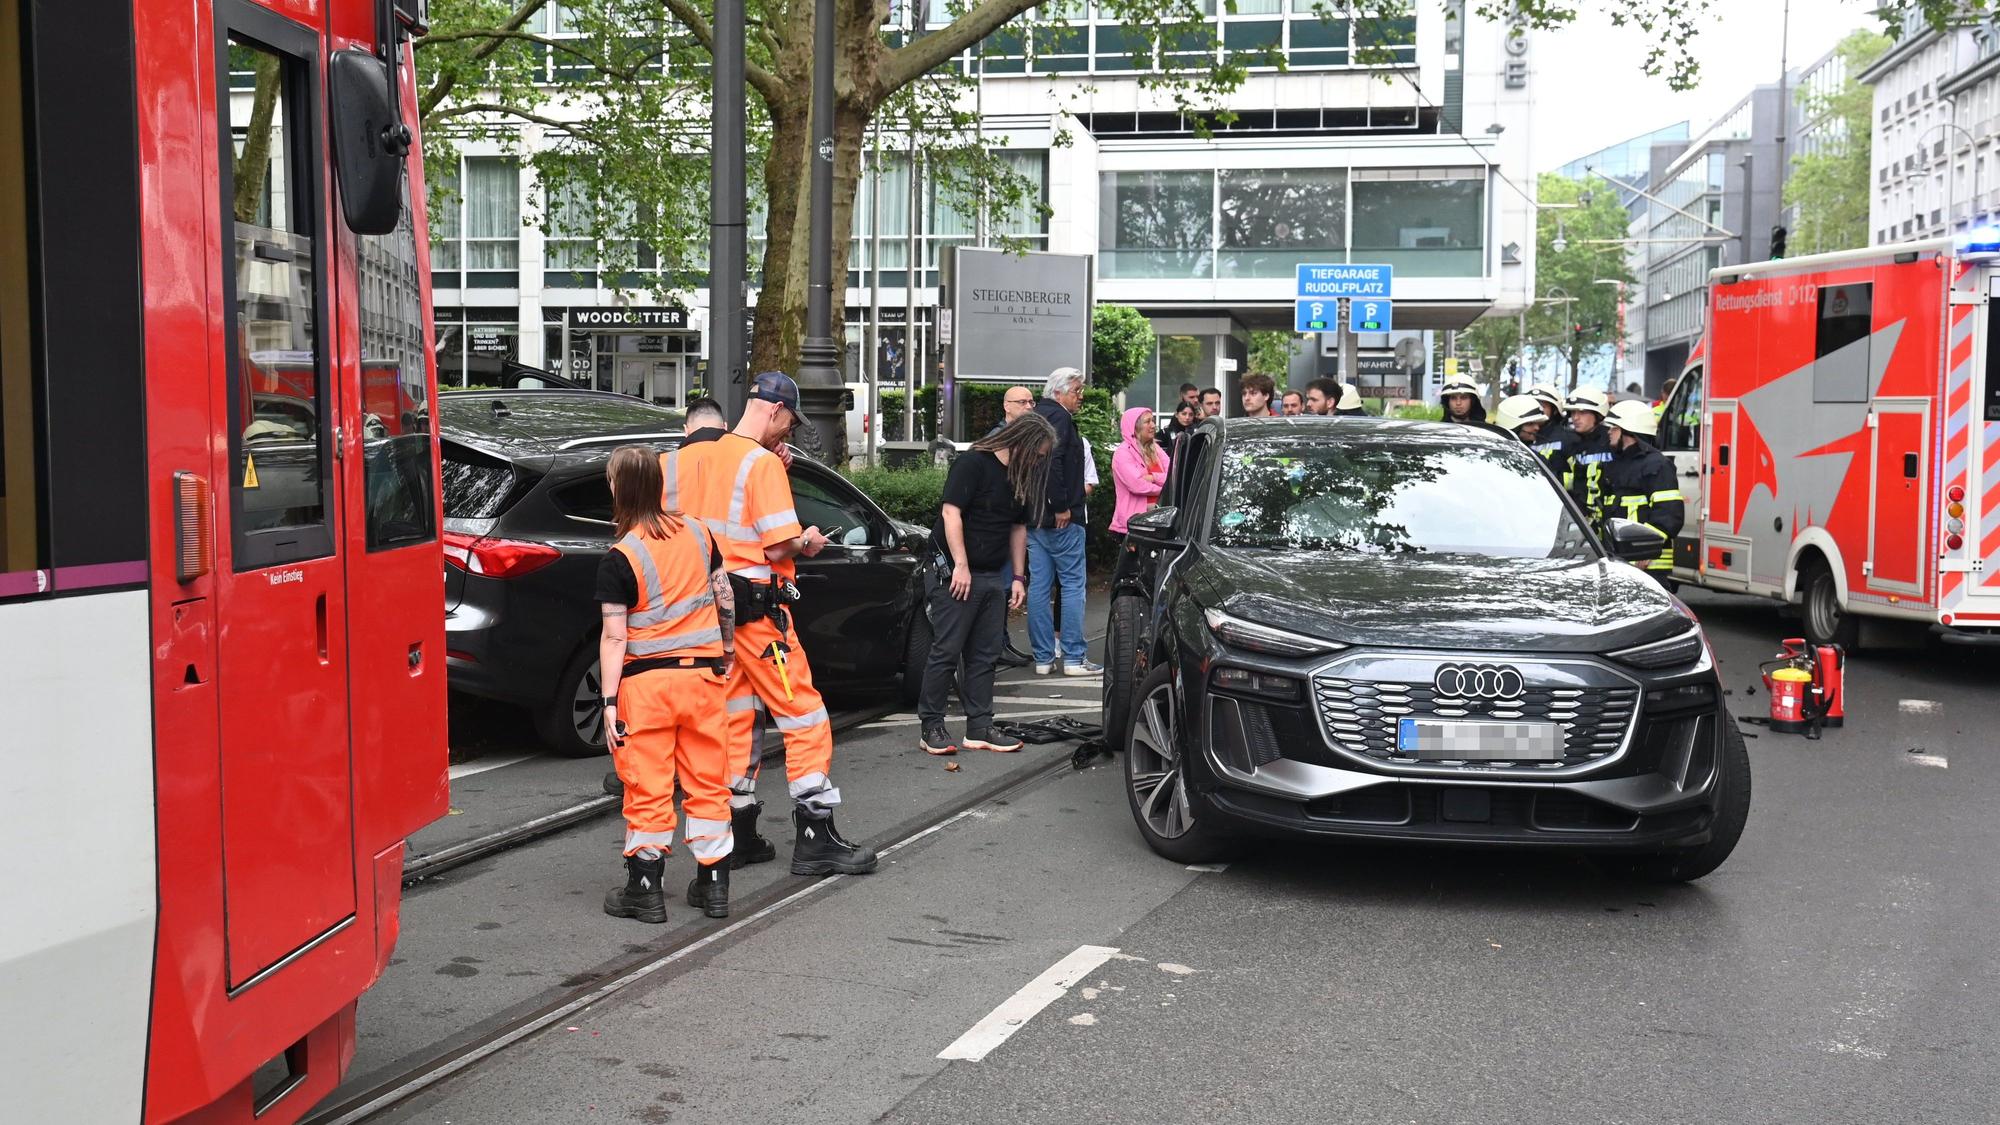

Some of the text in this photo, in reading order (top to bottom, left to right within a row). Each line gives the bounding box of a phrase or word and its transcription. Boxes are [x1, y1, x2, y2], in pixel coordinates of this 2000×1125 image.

[1310, 268, 1380, 280] TIEFGARAGE
[1305, 282, 1384, 294] RUDOLFPLATZ
[972, 288, 1072, 305] STEIGENBERGER
[1716, 289, 1783, 313] Rettungsdienst
[993, 305, 1052, 315] HOTEL
[576, 311, 680, 324] WOODCTTER
[551, 360, 590, 369] WOD
[1357, 361, 1394, 369] INFAHRT
